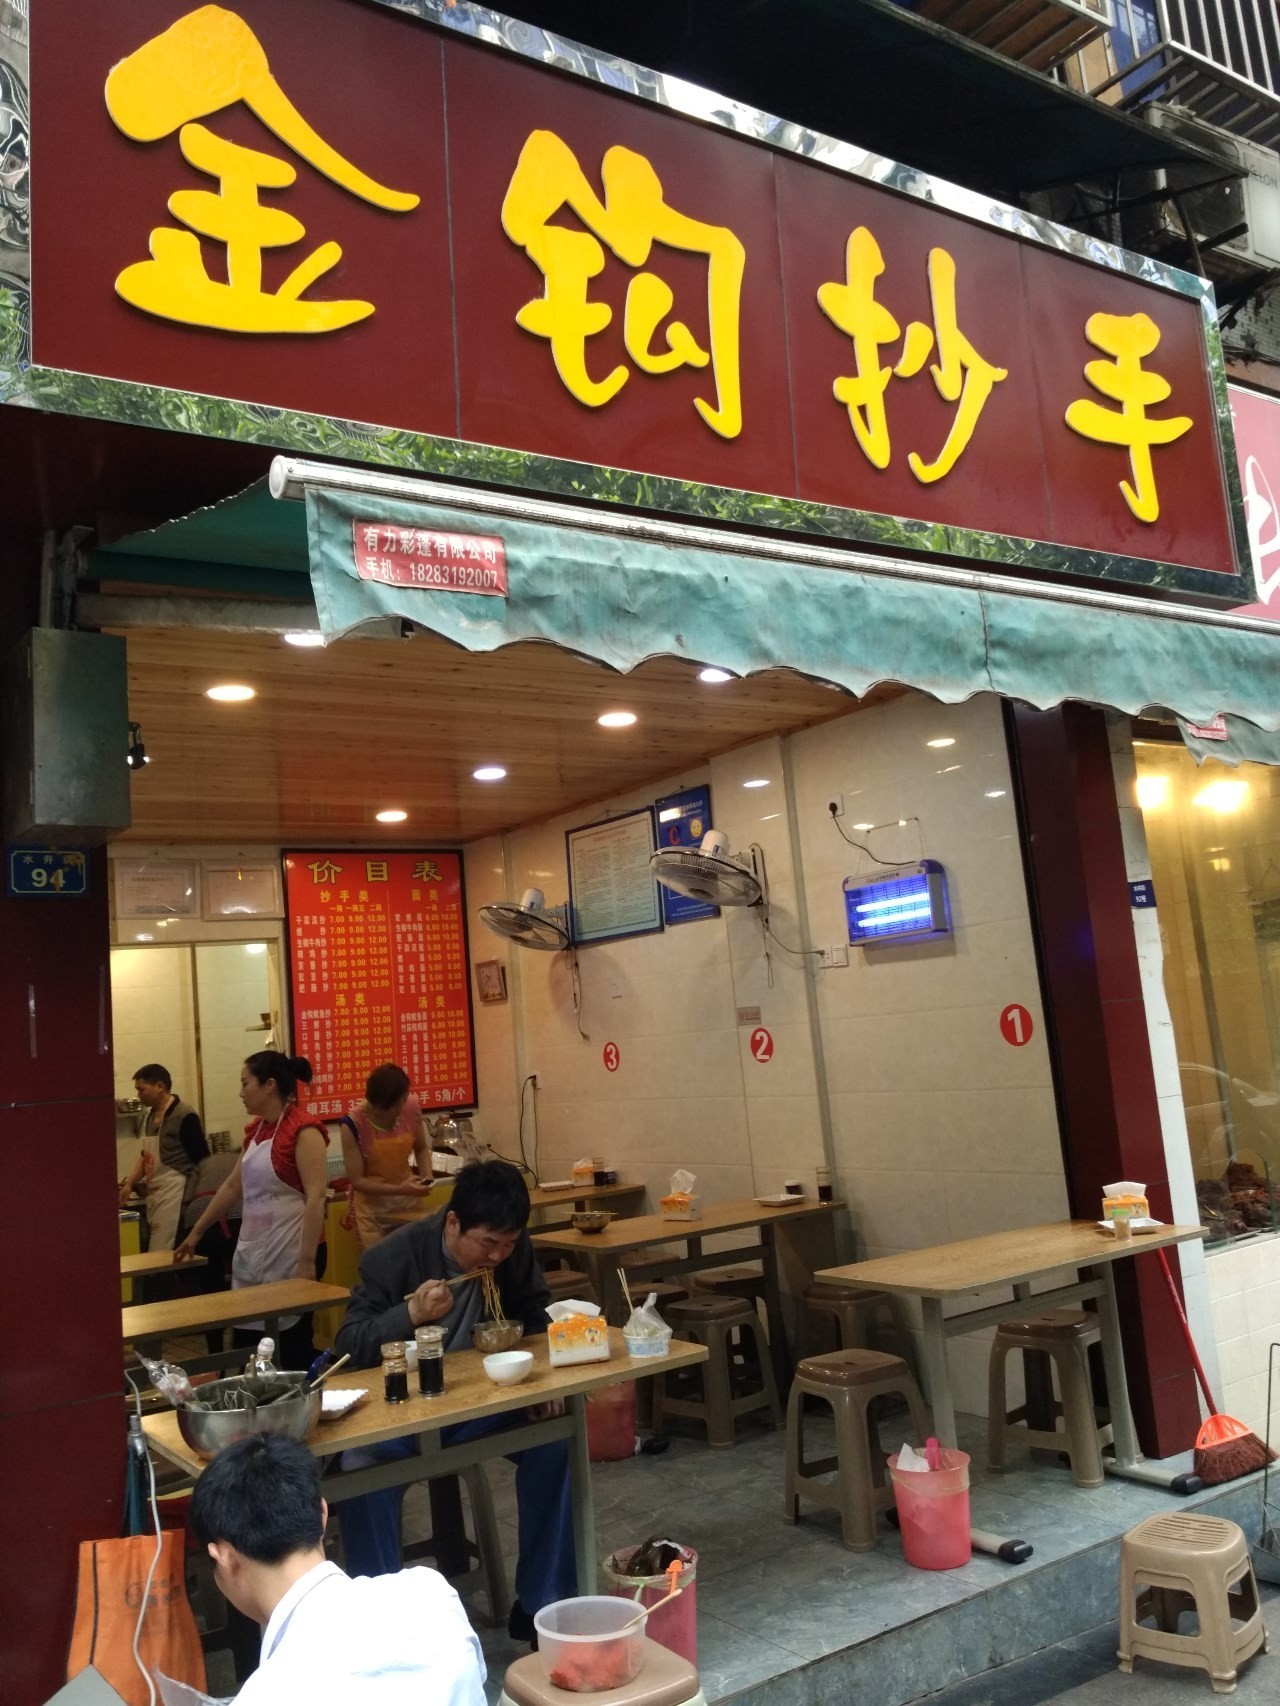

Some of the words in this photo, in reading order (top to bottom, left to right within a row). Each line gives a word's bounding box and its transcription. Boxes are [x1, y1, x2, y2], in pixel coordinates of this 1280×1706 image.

[104, 4, 1195, 524] 金钩抄手
[409, 562, 497, 588] 18283192007
[307, 859, 443, 884] 价目表
[31, 868, 66, 888] 94
[320, 890, 368, 902] 抄手类
[412, 889, 438, 901] 面类
[336, 993, 365, 1006] 汤类
[419, 996, 445, 1008] 汤类
[334, 1008, 349, 1016] 7.00
[373, 1016, 391, 1024] 12.00
[448, 1020, 464, 1028] 10.00
[1007, 1008, 1024, 1043] 1
[354, 1028, 369, 1036] 9.00
[449, 1030, 465, 1038] 10.00
[335, 1040, 350, 1048] 7.00
[755, 1031, 770, 1060] 2
[606, 1043, 617, 1070] 3
[355, 1060, 370, 1068] 9.00
[435, 1087, 465, 1102] 5角/个
[306, 1100, 342, 1115] 银耳汤
